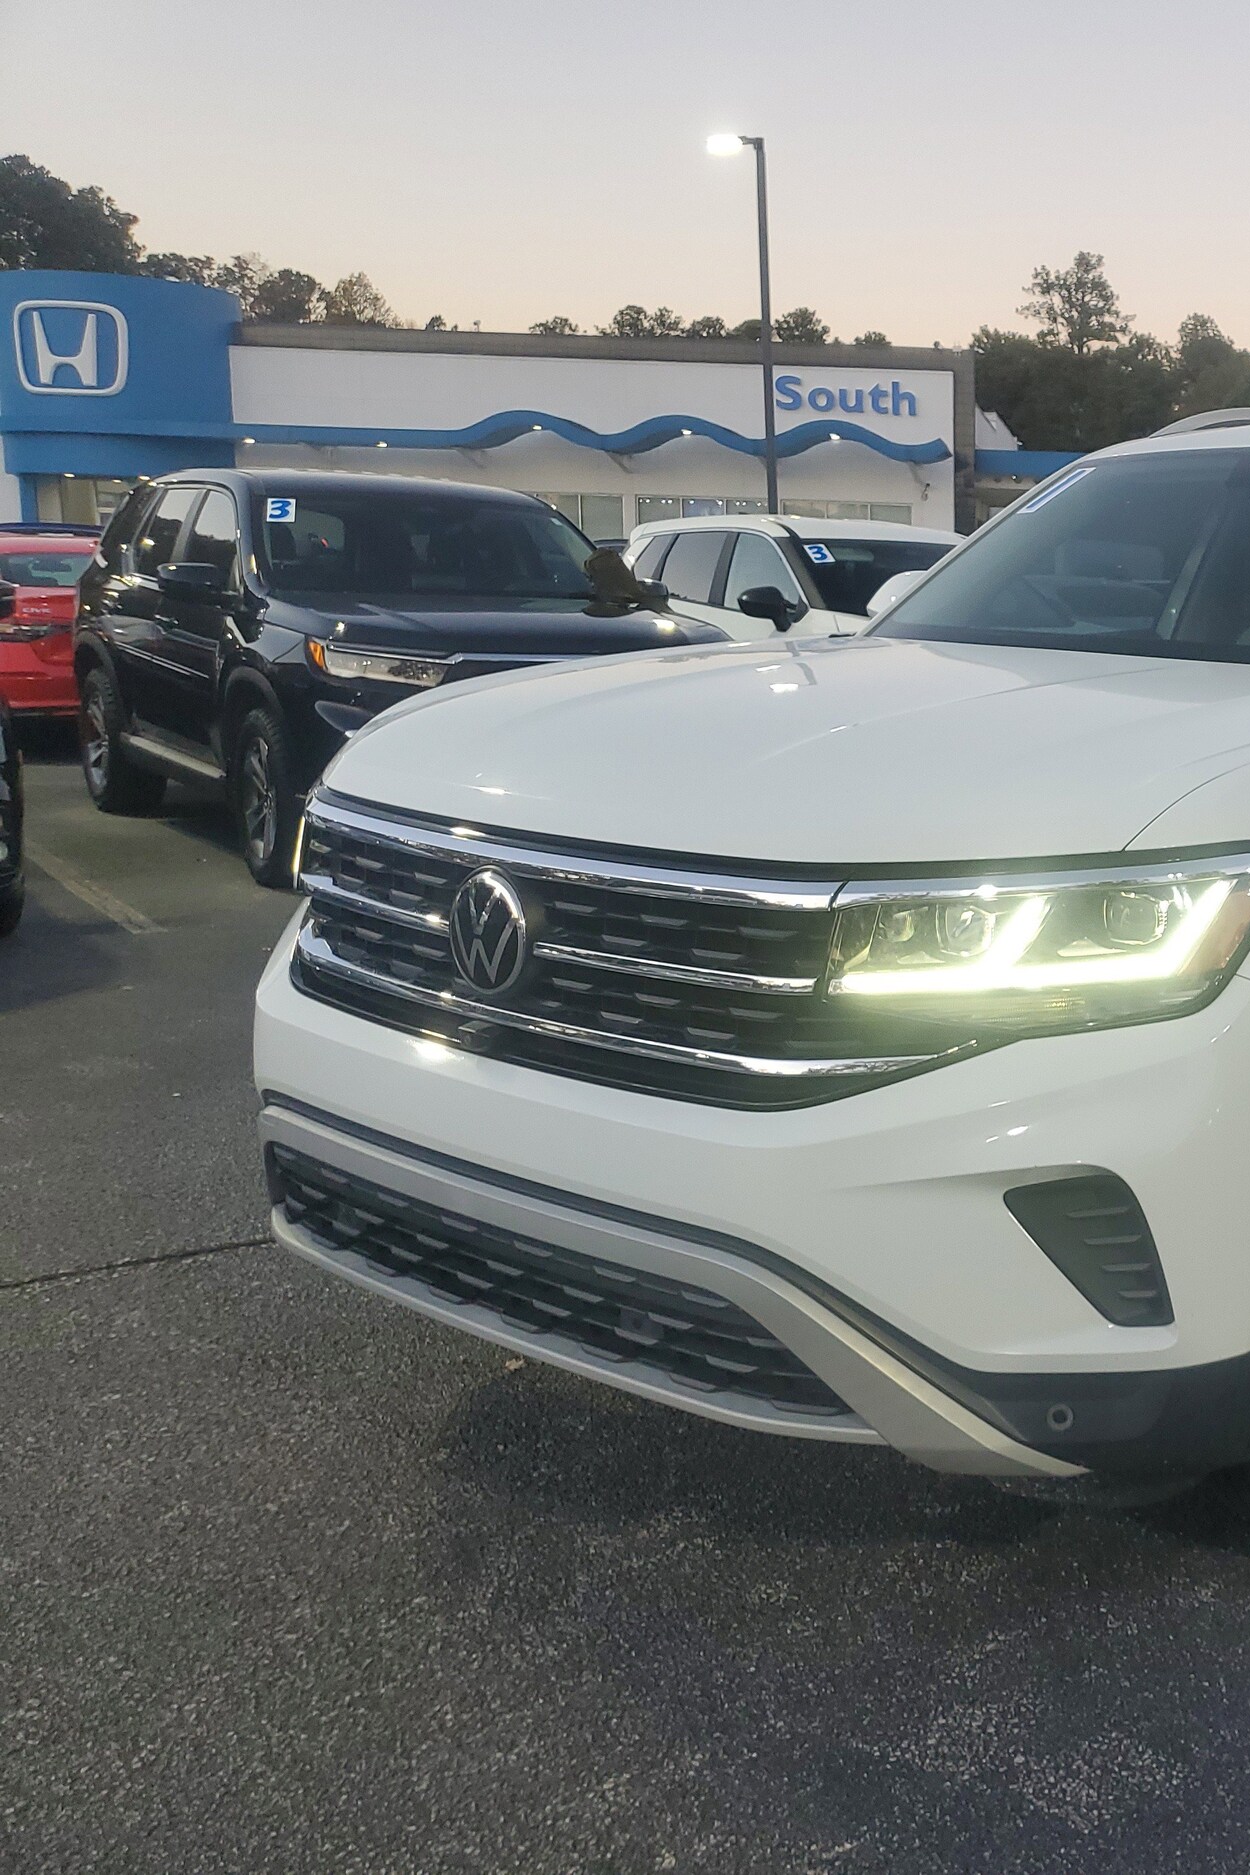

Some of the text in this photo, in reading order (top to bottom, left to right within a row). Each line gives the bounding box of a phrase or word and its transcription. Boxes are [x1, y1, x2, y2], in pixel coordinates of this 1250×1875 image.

[775, 375, 917, 416] South
[269, 500, 291, 519] 3
[807, 545, 828, 561] 3
